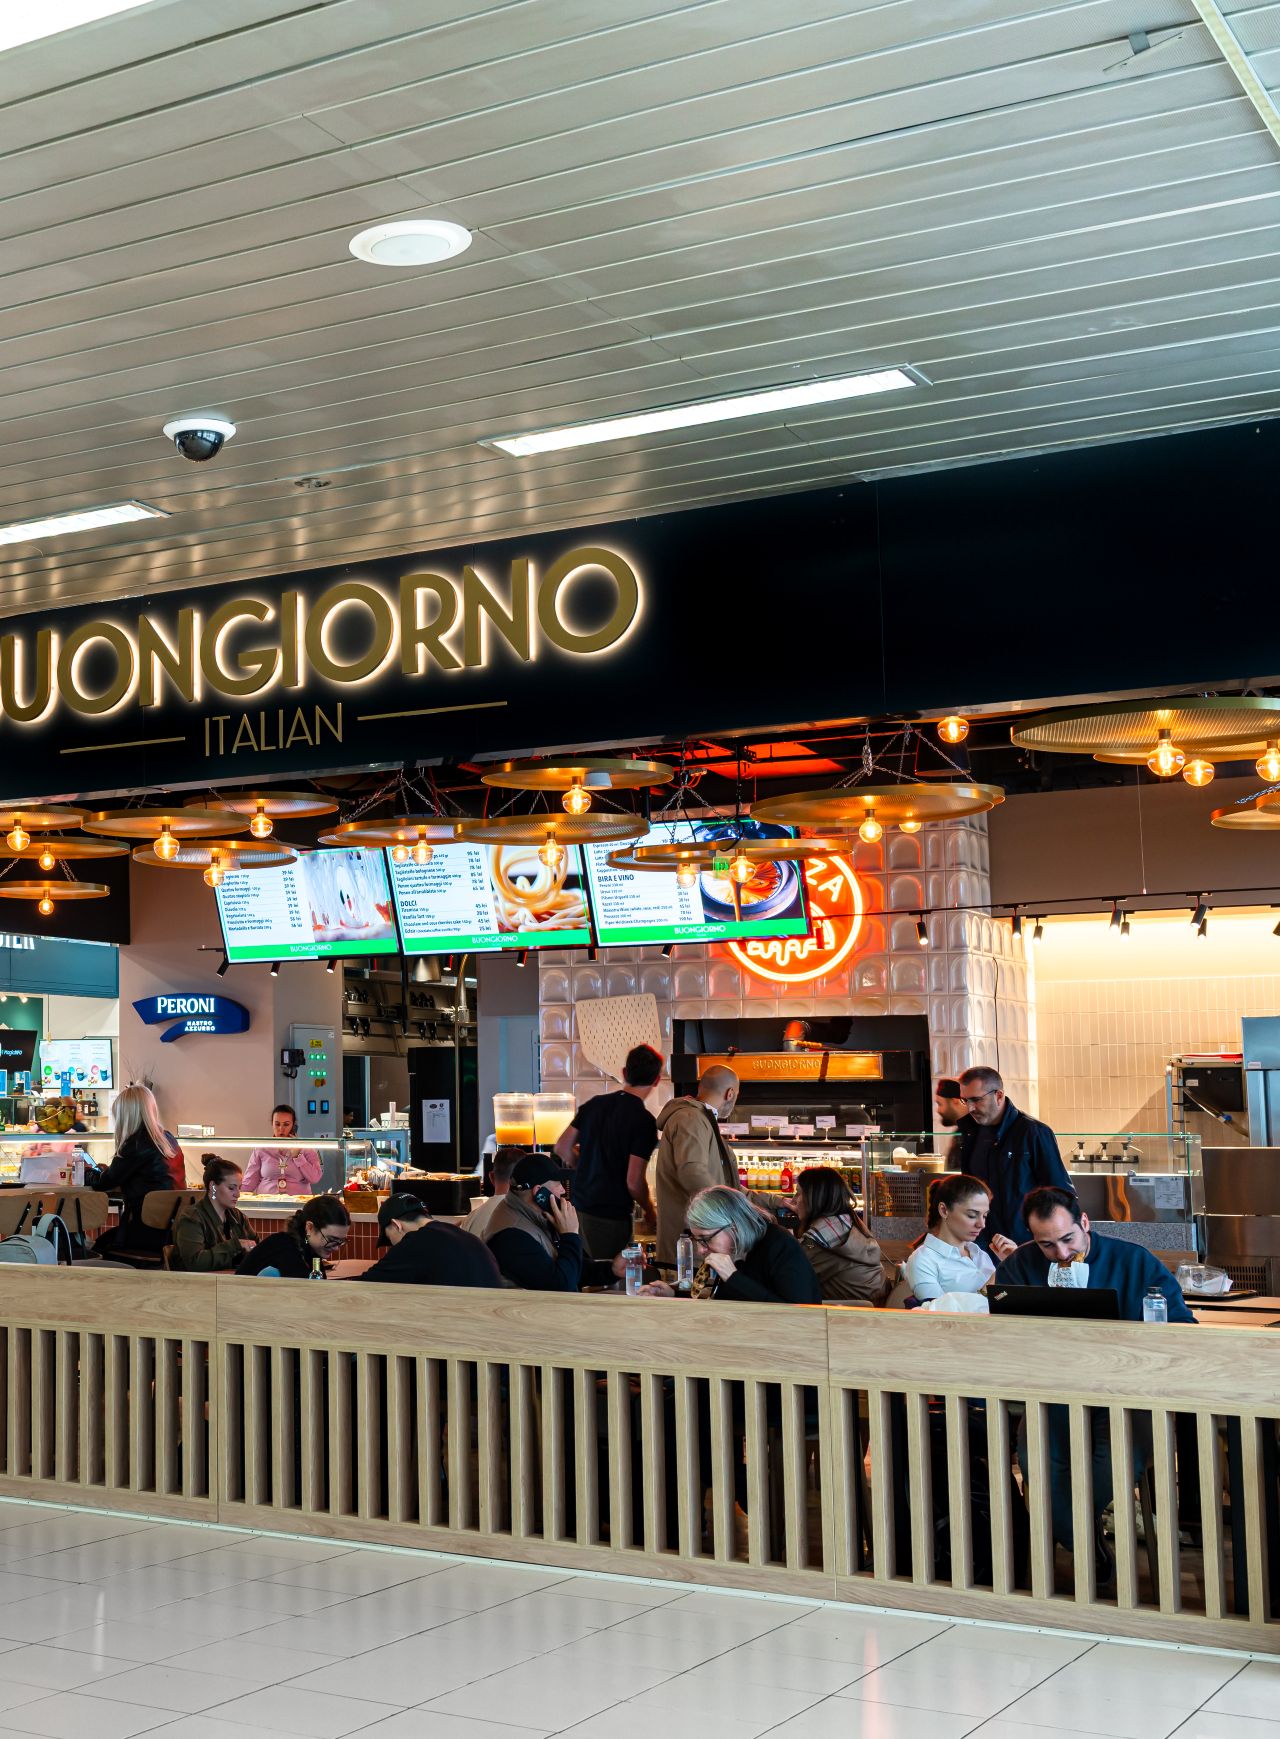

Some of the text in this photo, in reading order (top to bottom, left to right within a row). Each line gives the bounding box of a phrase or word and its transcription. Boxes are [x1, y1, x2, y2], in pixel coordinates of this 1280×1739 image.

[204, 703, 344, 757] ITALIAN
[617, 873, 634, 881] VINO
[673, 925, 726, 935] BUONGIORNO
[472, 935, 518, 944] BUONGIORNO
[290, 944, 332, 953] BUONGIORNO
[157, 996, 215, 1014] PERONI
[752, 1059, 821, 1070] BUONGIORNO
